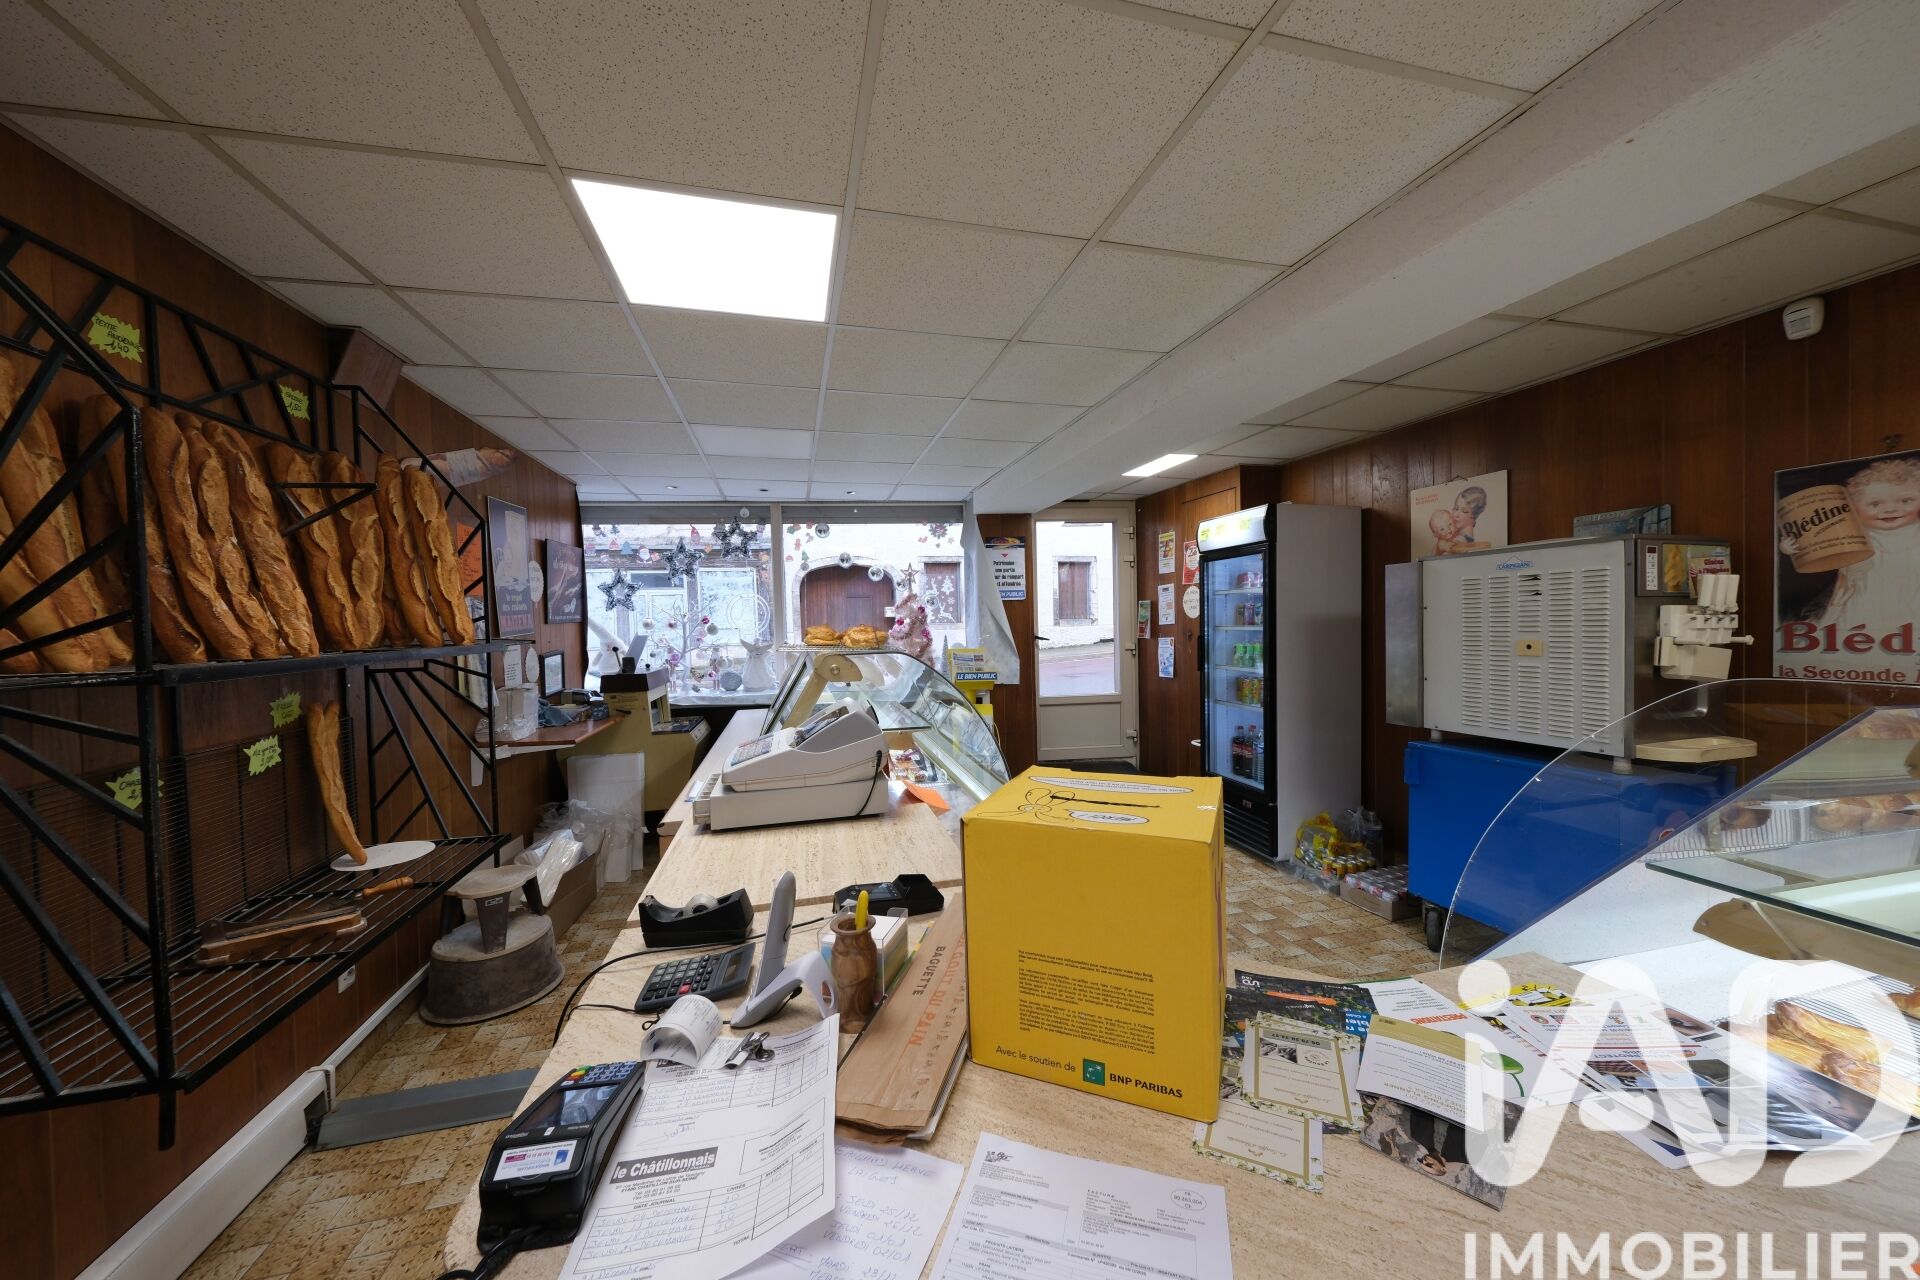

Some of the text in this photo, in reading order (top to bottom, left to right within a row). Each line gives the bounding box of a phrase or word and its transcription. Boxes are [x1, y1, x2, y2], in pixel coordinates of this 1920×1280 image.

[1780, 503, 1852, 538] Blédine
[1776, 621, 1920, 653] Bléd
[1778, 665, 1906, 682] la Seconde
[912, 946, 946, 996] BAGUETTE
[908, 1010, 936, 1046] PAIN
[1410, 1012, 1467, 1025] PRESTATIONS
[996, 1045, 1182, 1098] Avec le soutien de BNP PARIBAS
[613, 1152, 715, 1180] le Châtillonnais
[649, 1198, 675, 1206] JOURNAL
